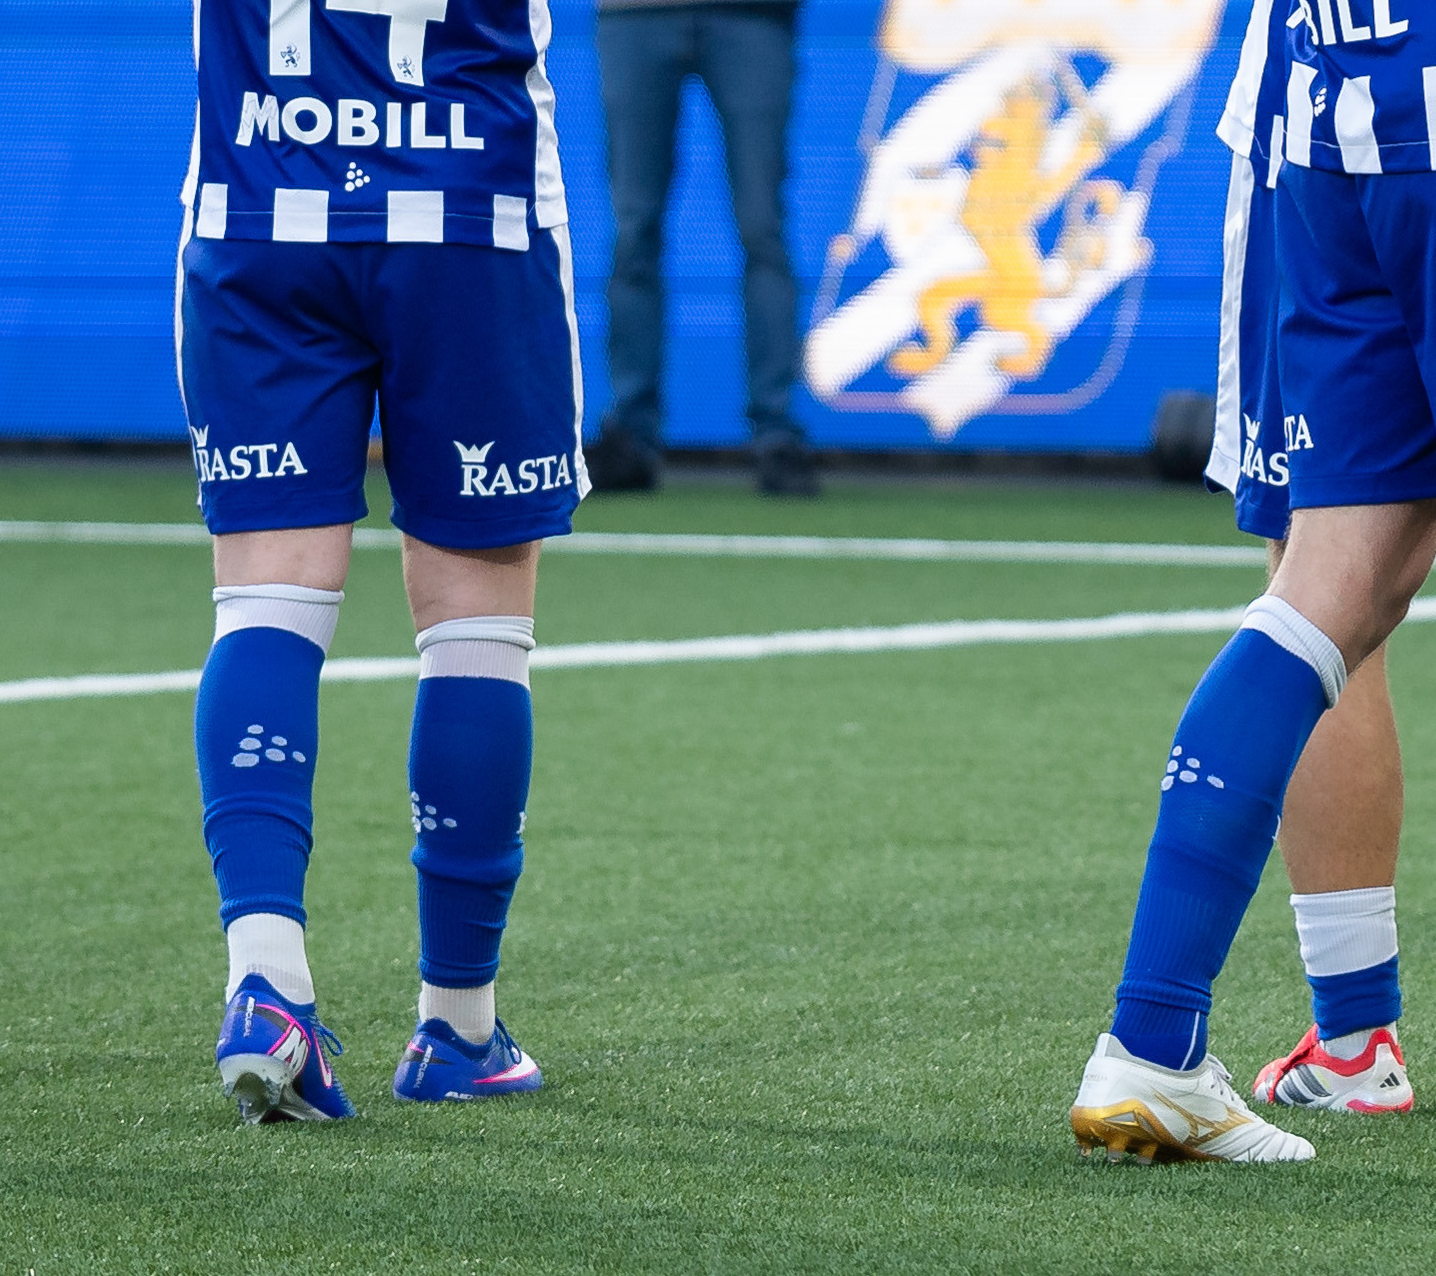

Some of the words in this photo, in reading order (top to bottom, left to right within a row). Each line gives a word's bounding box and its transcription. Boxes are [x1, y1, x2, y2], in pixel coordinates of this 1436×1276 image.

[235, 92, 485, 150] MOBILL
[197, 442, 308, 482] RASTA
[461, 453, 572, 496] RASTA
[1241, 440, 1289, 486] RAS
